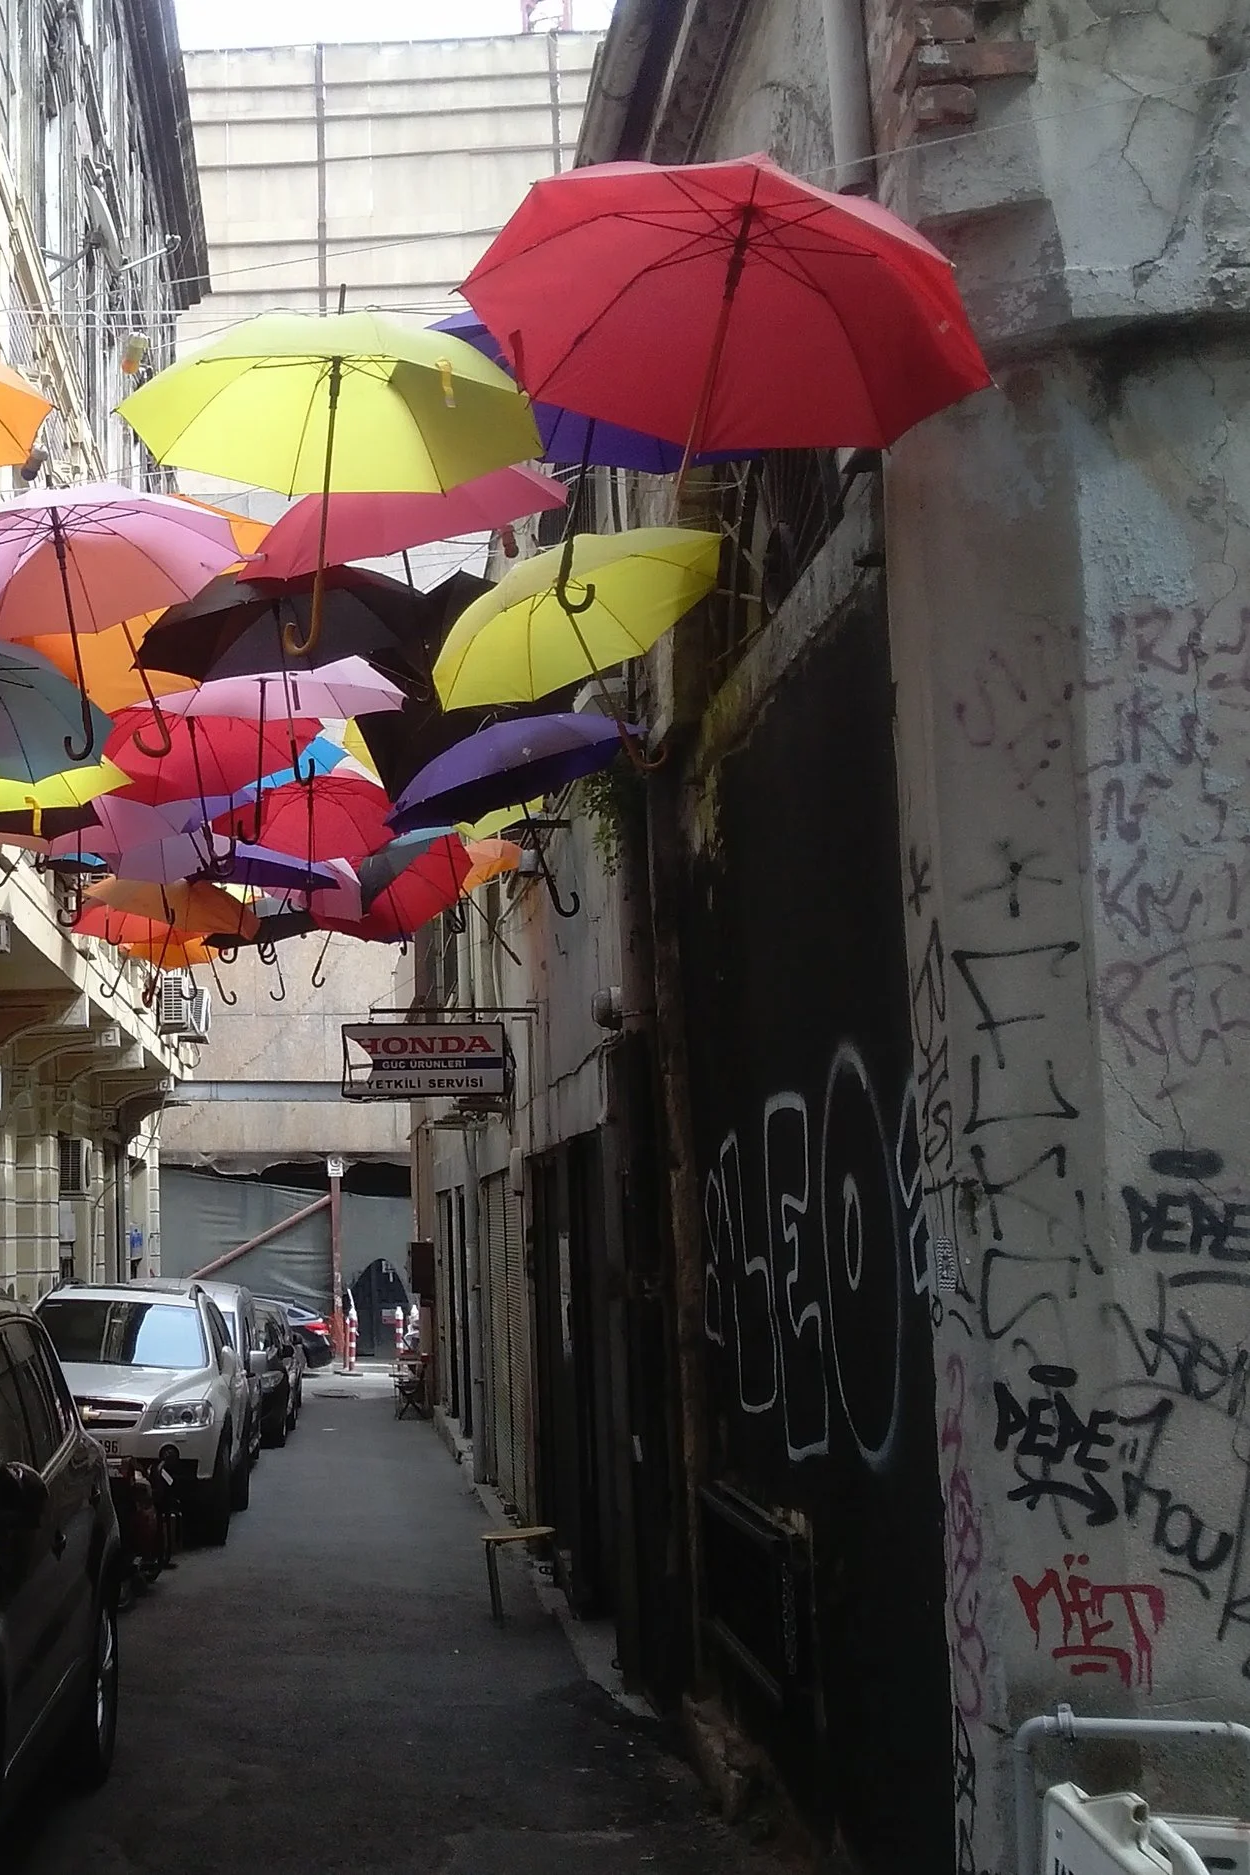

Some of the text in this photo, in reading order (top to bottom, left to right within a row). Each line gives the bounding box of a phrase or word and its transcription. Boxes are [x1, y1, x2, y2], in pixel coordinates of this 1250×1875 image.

[356, 1035, 496, 1056] HONDA
[366, 1075, 484, 1090] YETKİLİ SERVİSİ
[993, 1380, 1118, 1473] PEPE
[98, 1439, 119, 1454] 96
